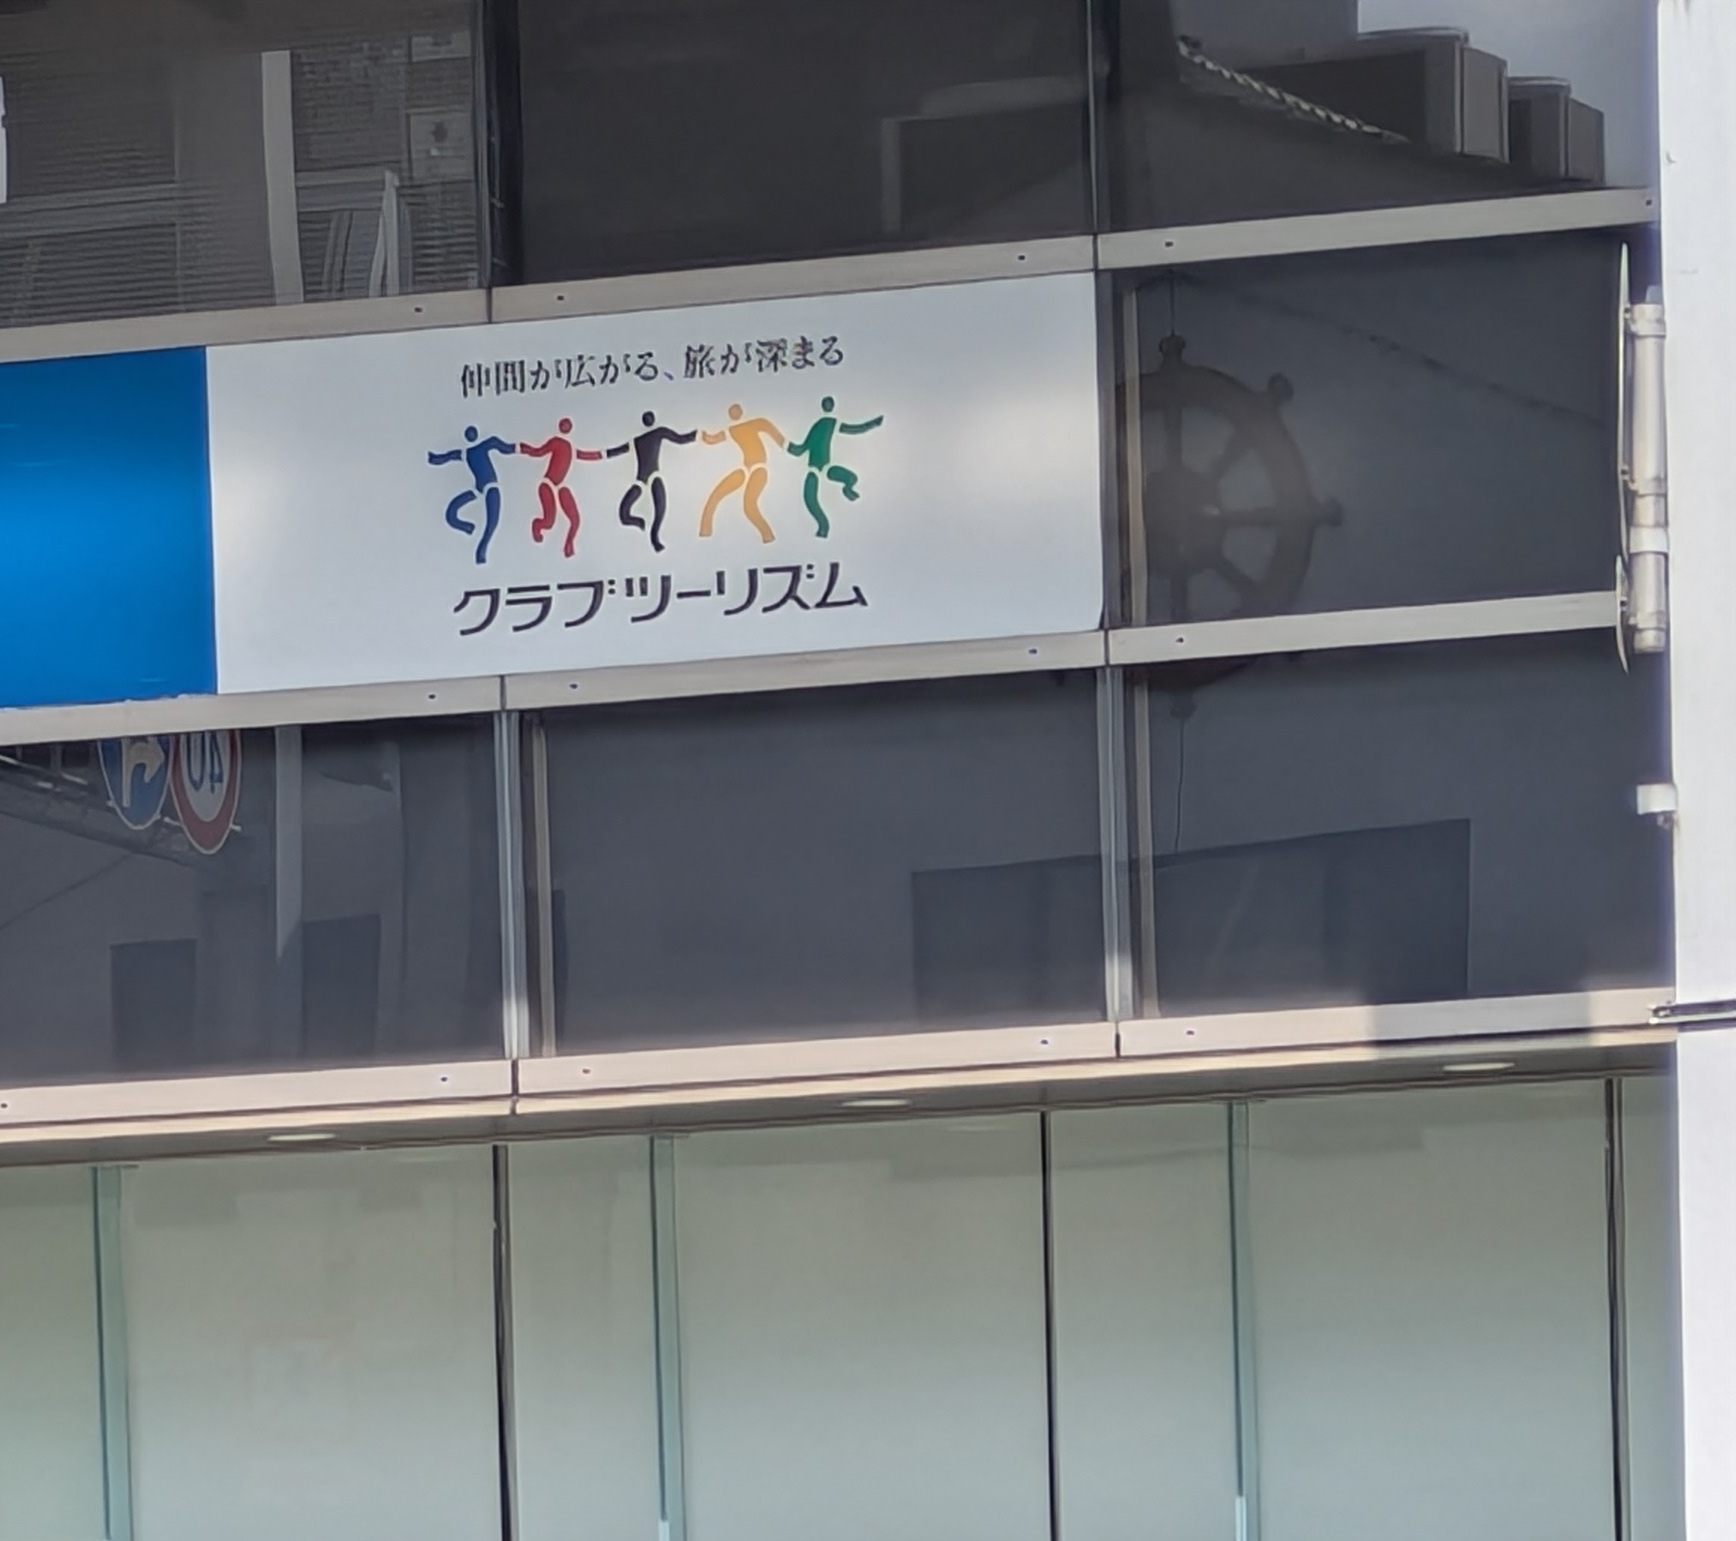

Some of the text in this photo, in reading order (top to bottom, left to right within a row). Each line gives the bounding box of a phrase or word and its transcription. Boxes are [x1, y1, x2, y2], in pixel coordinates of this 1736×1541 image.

[461, 336, 845, 397] 仲間が広がる、旅が深まる
[452, 562, 870, 638] クラブツーリズム
